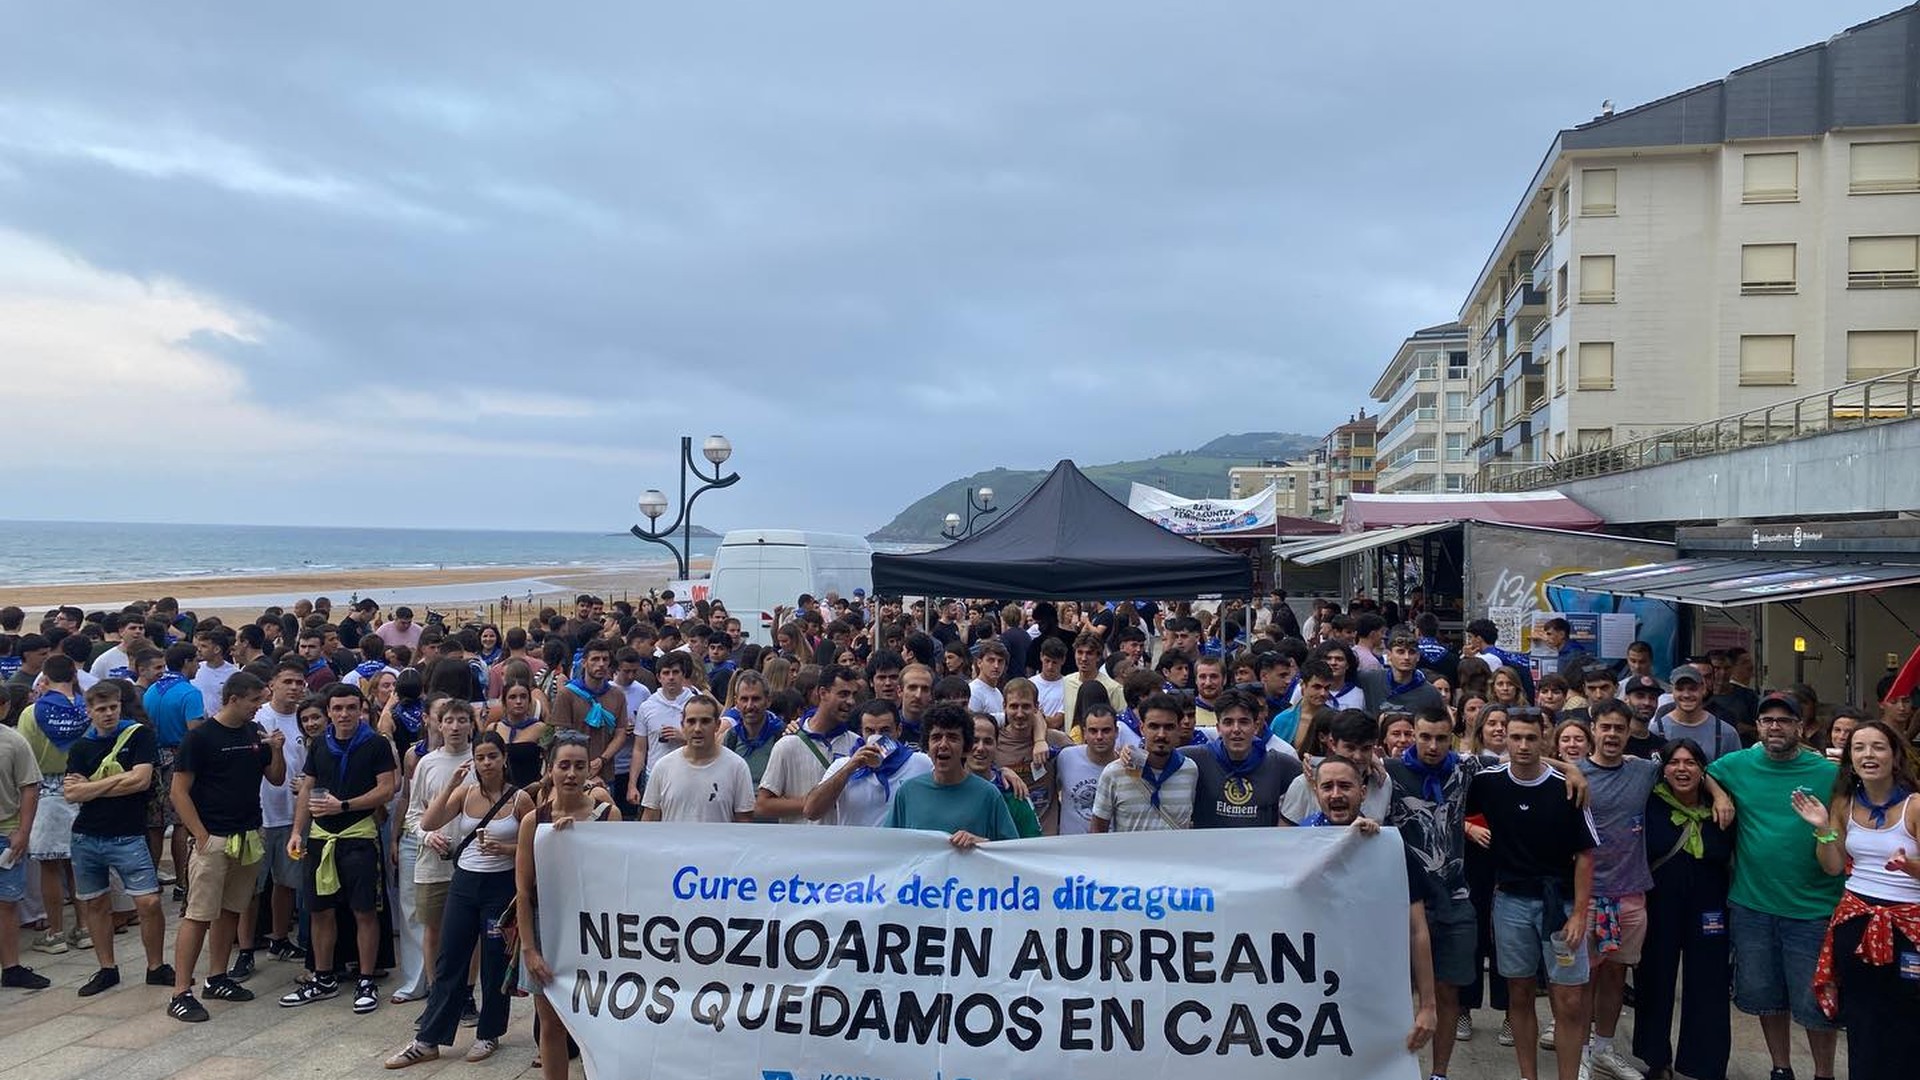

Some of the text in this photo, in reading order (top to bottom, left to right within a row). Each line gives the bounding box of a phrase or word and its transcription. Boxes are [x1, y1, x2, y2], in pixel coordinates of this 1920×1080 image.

[1216, 801, 1258, 814] Element
[672, 866, 1215, 920] Gure etxeak defenda ditzagun
[579, 911, 1340, 997] NEGOZIOAREN AURREAN,
[572, 969, 1354, 1060] NOS QUEDAMOS EN CASA
